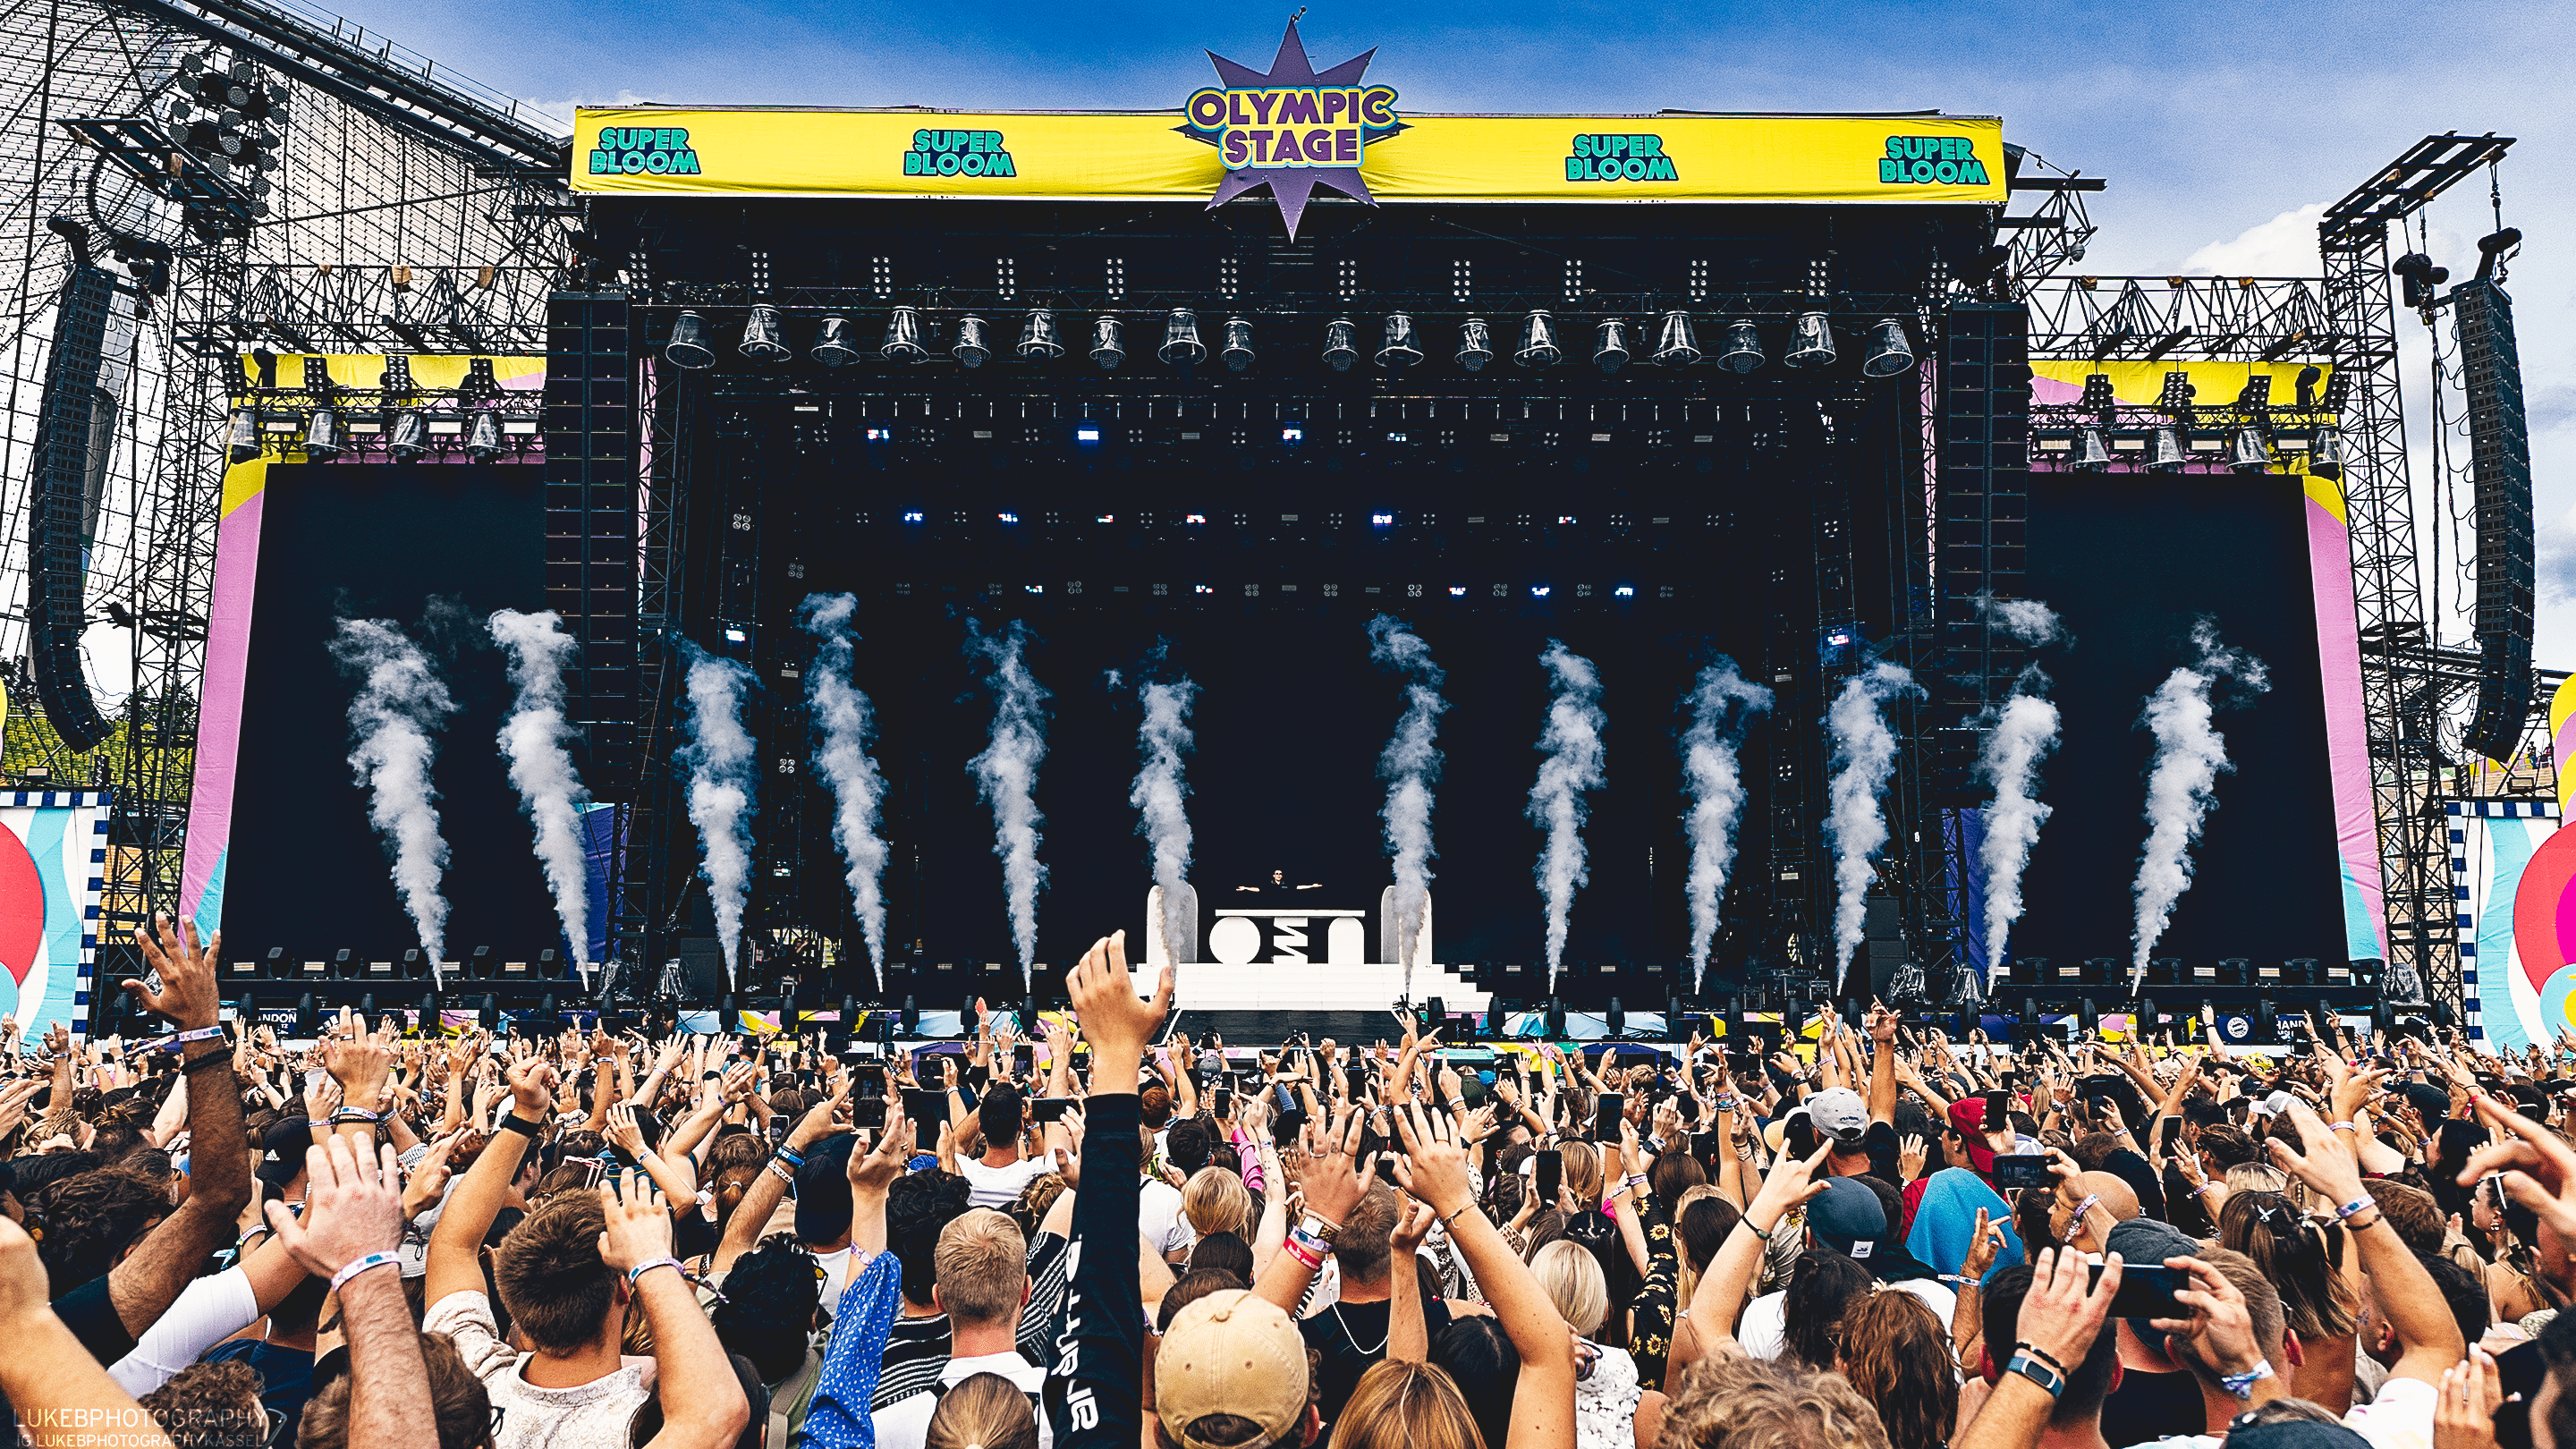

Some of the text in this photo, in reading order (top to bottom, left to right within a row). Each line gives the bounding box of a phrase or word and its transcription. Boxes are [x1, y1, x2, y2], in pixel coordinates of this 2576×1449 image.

[1191, 90, 1392, 126] OLYMPIC
[600, 128, 689, 149] SUPER
[913, 130, 1003, 153] SUPER
[1224, 129, 1358, 163] STAGE
[1573, 135, 1663, 157] SUPER
[1886, 137, 1976, 161] SUPER
[589, 150, 700, 174] BLOOM
[904, 153, 1015, 175] BLOOM
[1566, 157, 1678, 180] BLOOM
[1879, 159, 1988, 183] BLOOM
